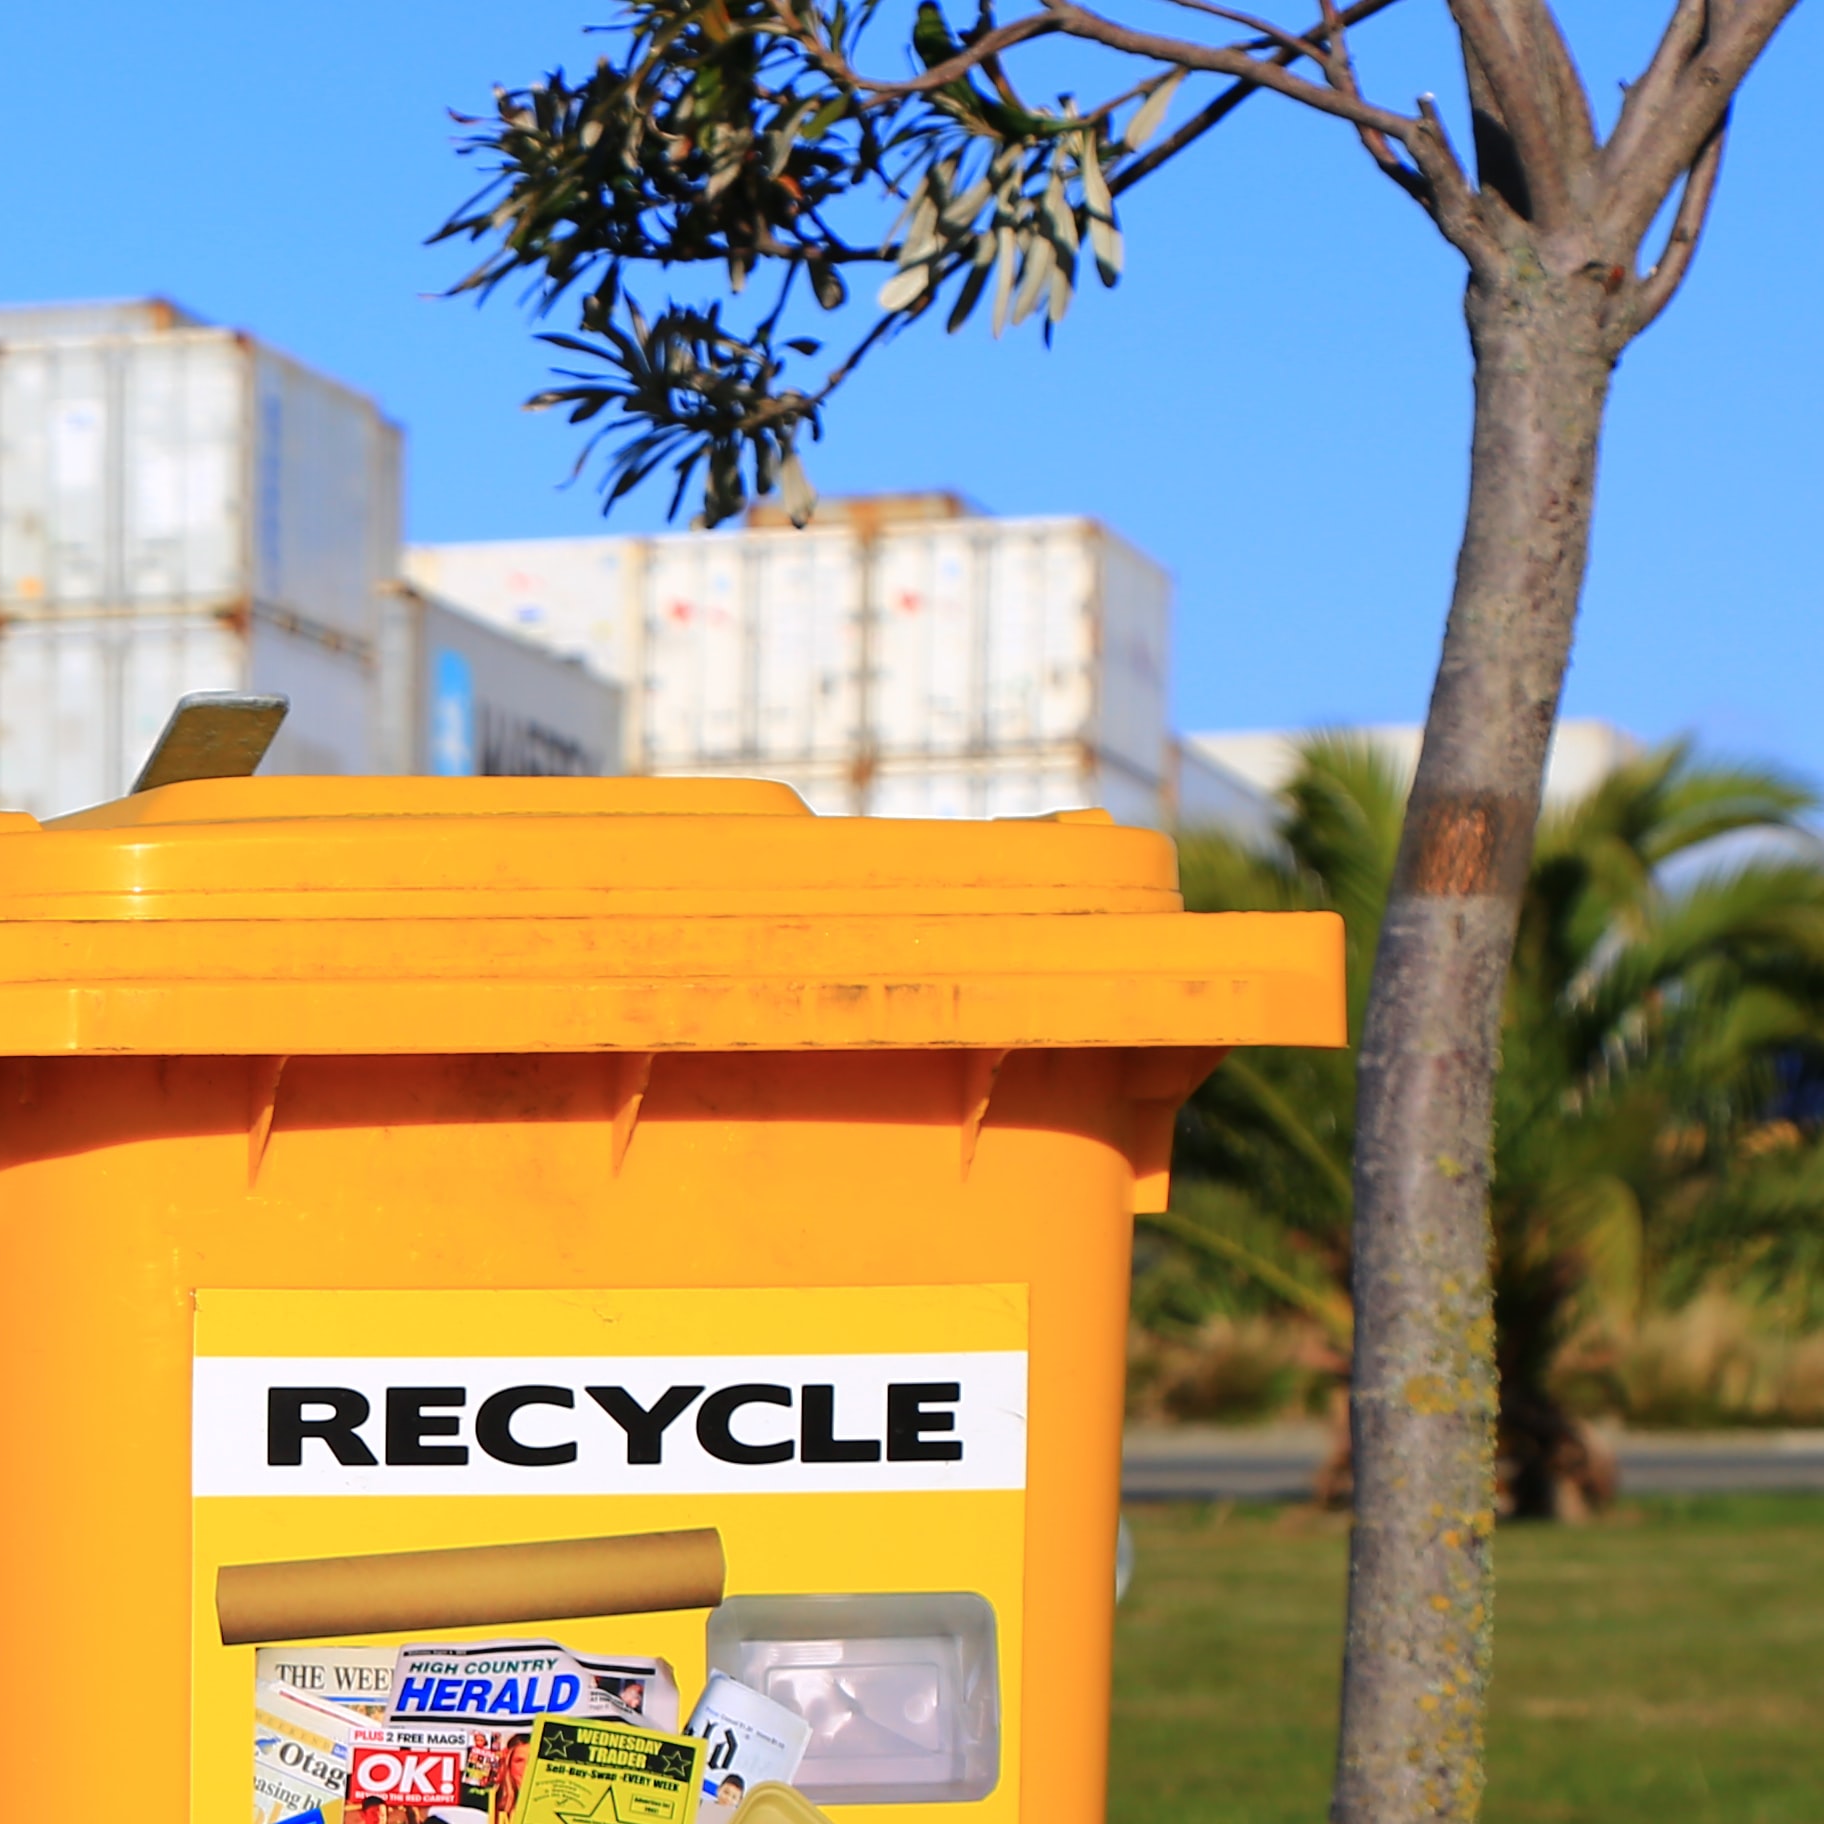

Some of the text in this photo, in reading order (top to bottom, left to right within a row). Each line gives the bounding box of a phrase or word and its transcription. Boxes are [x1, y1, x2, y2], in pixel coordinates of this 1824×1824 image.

[266, 1382, 963, 1467] RECYCLE
[275, 1663, 325, 1690] THE
[410, 1656, 560, 1677] HIGH COUNTRY
[394, 1672, 582, 1716] HERALD
[353, 1729, 466, 1746] PLUS 2 FREE MAGS
[576, 1727, 664, 1757] WEDNESDAY
[278, 1741, 348, 1791] Otag
[588, 1745, 648, 1769] TRADER
[356, 1752, 456, 1796] OK!
[652, 1778, 680, 1793] WEEK
[389, 1792, 456, 1804] THE RED CARPET
